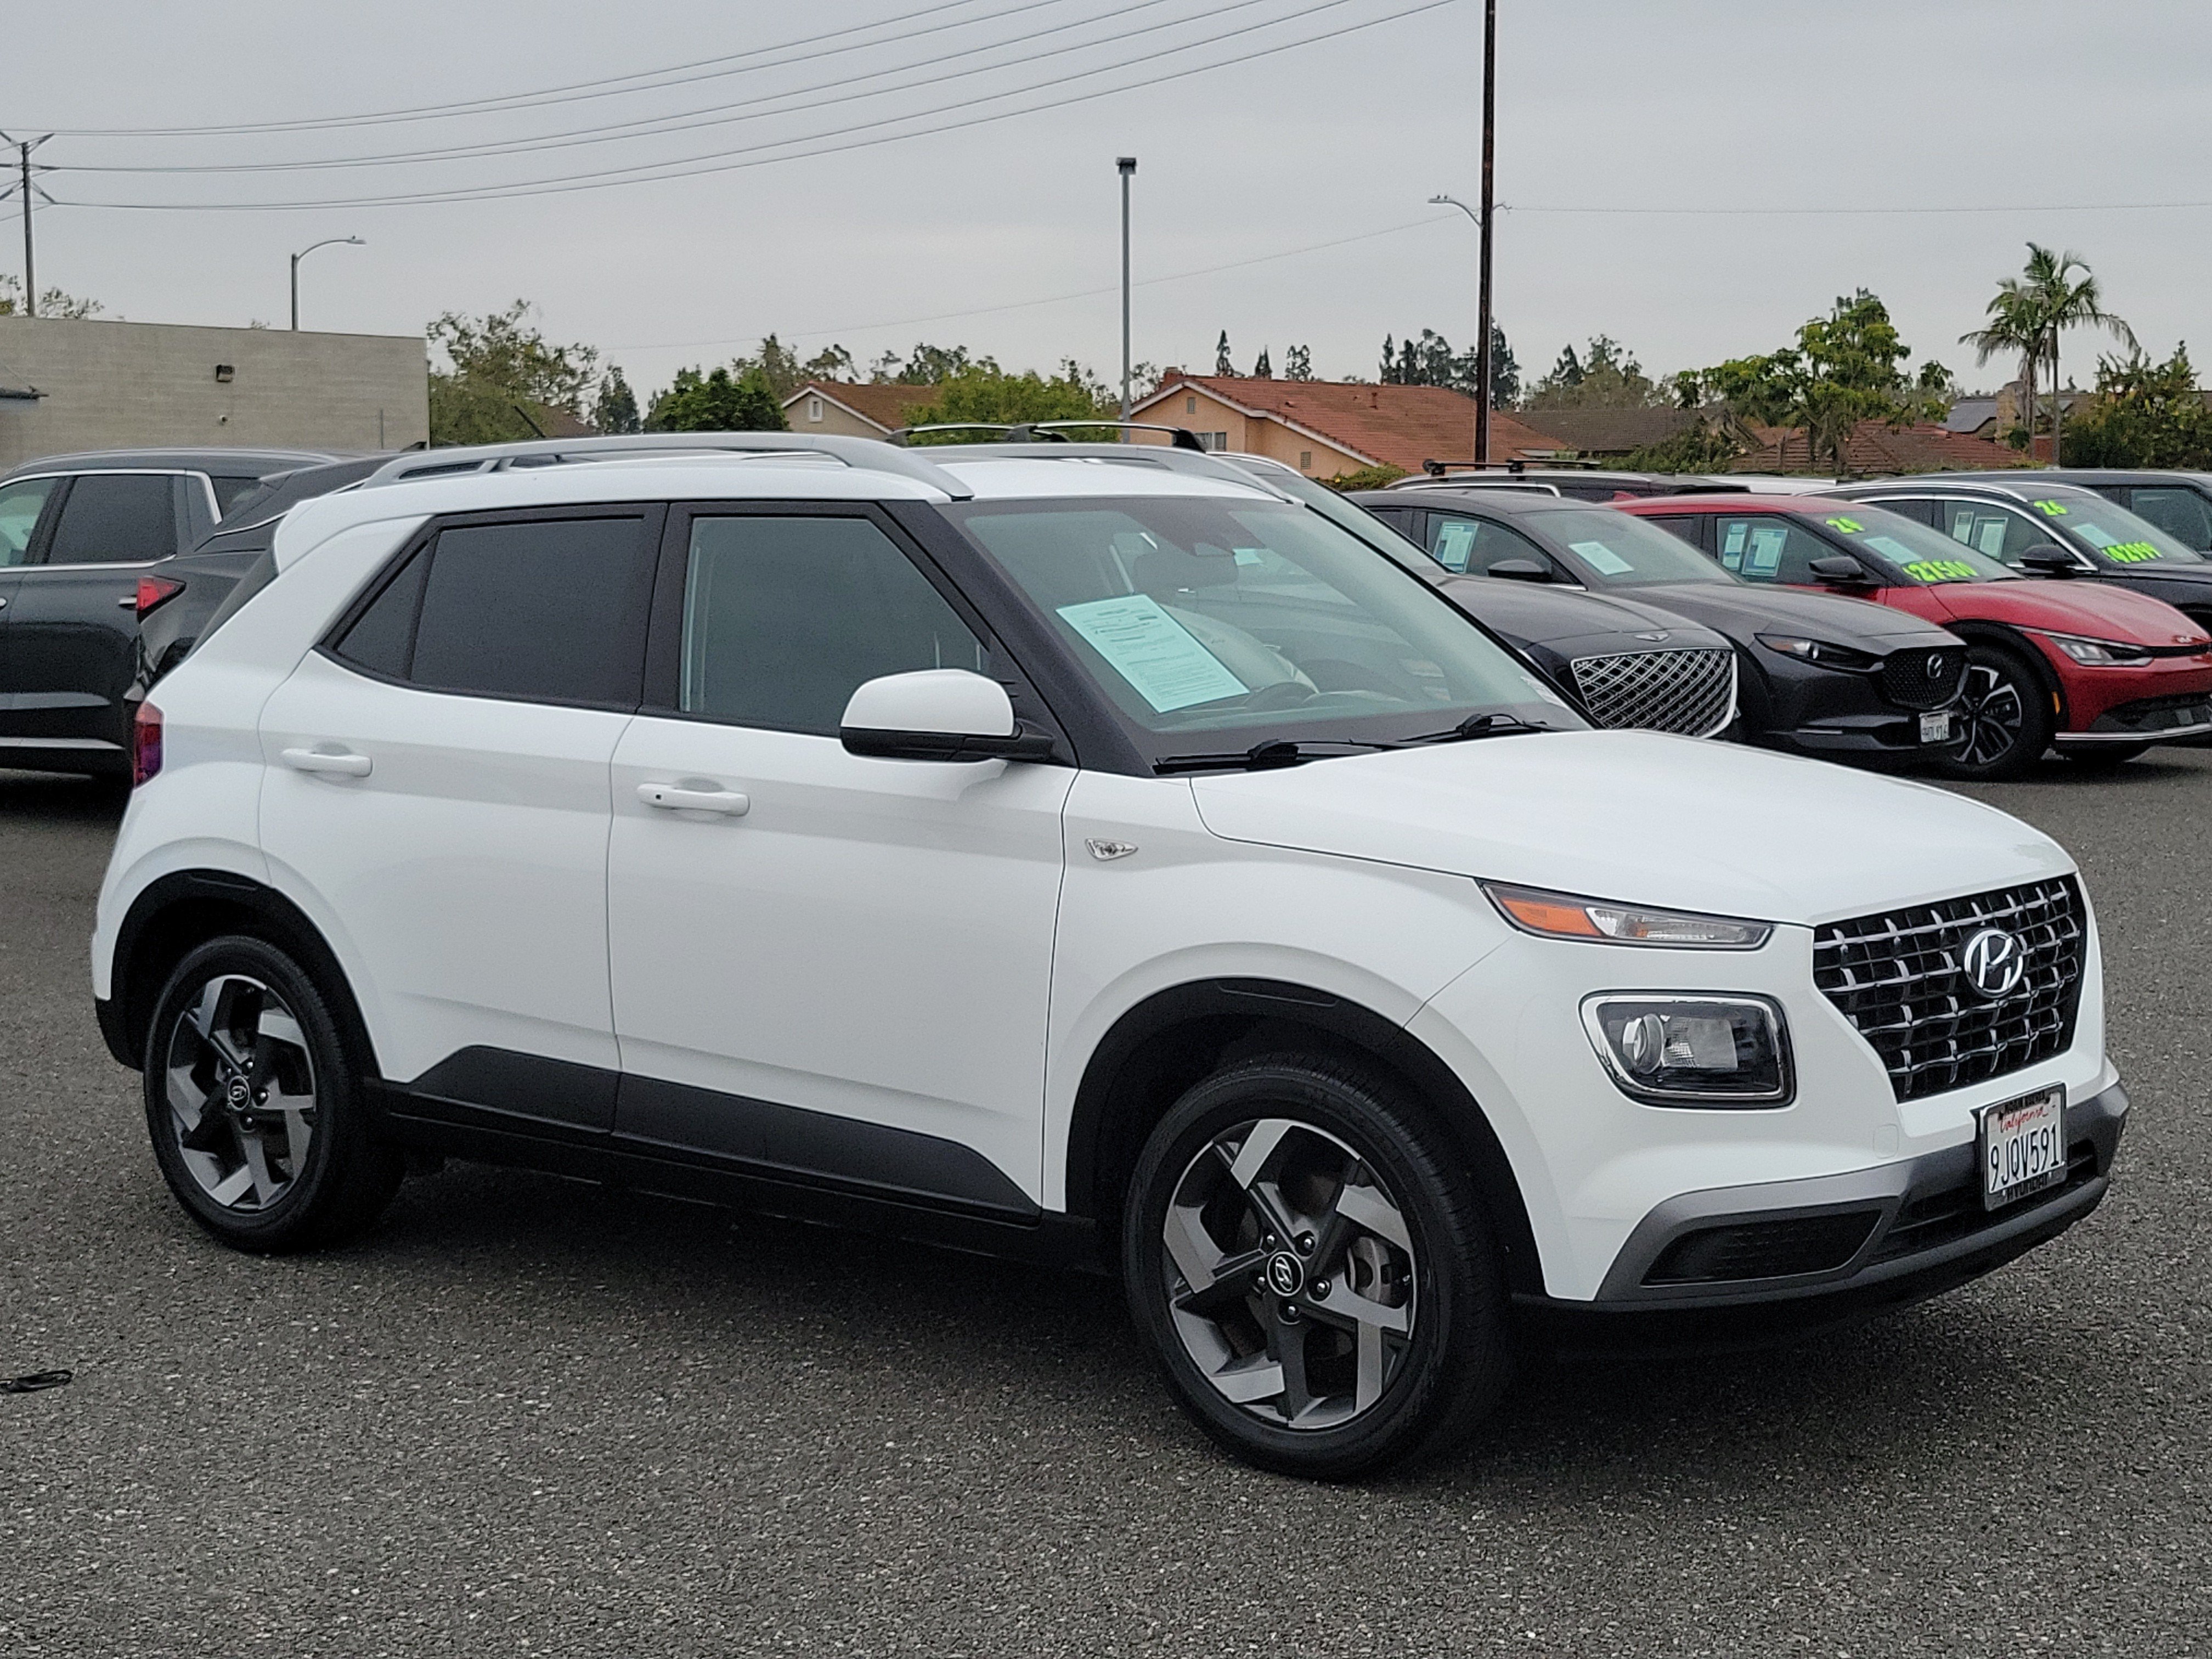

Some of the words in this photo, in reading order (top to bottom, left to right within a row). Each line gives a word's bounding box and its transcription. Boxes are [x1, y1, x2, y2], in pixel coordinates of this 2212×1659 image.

[2033, 499, 2068, 516] 26
[2000, 1106, 2049, 1133] California
[1990, 1122, 2059, 1192] 9JQV591
